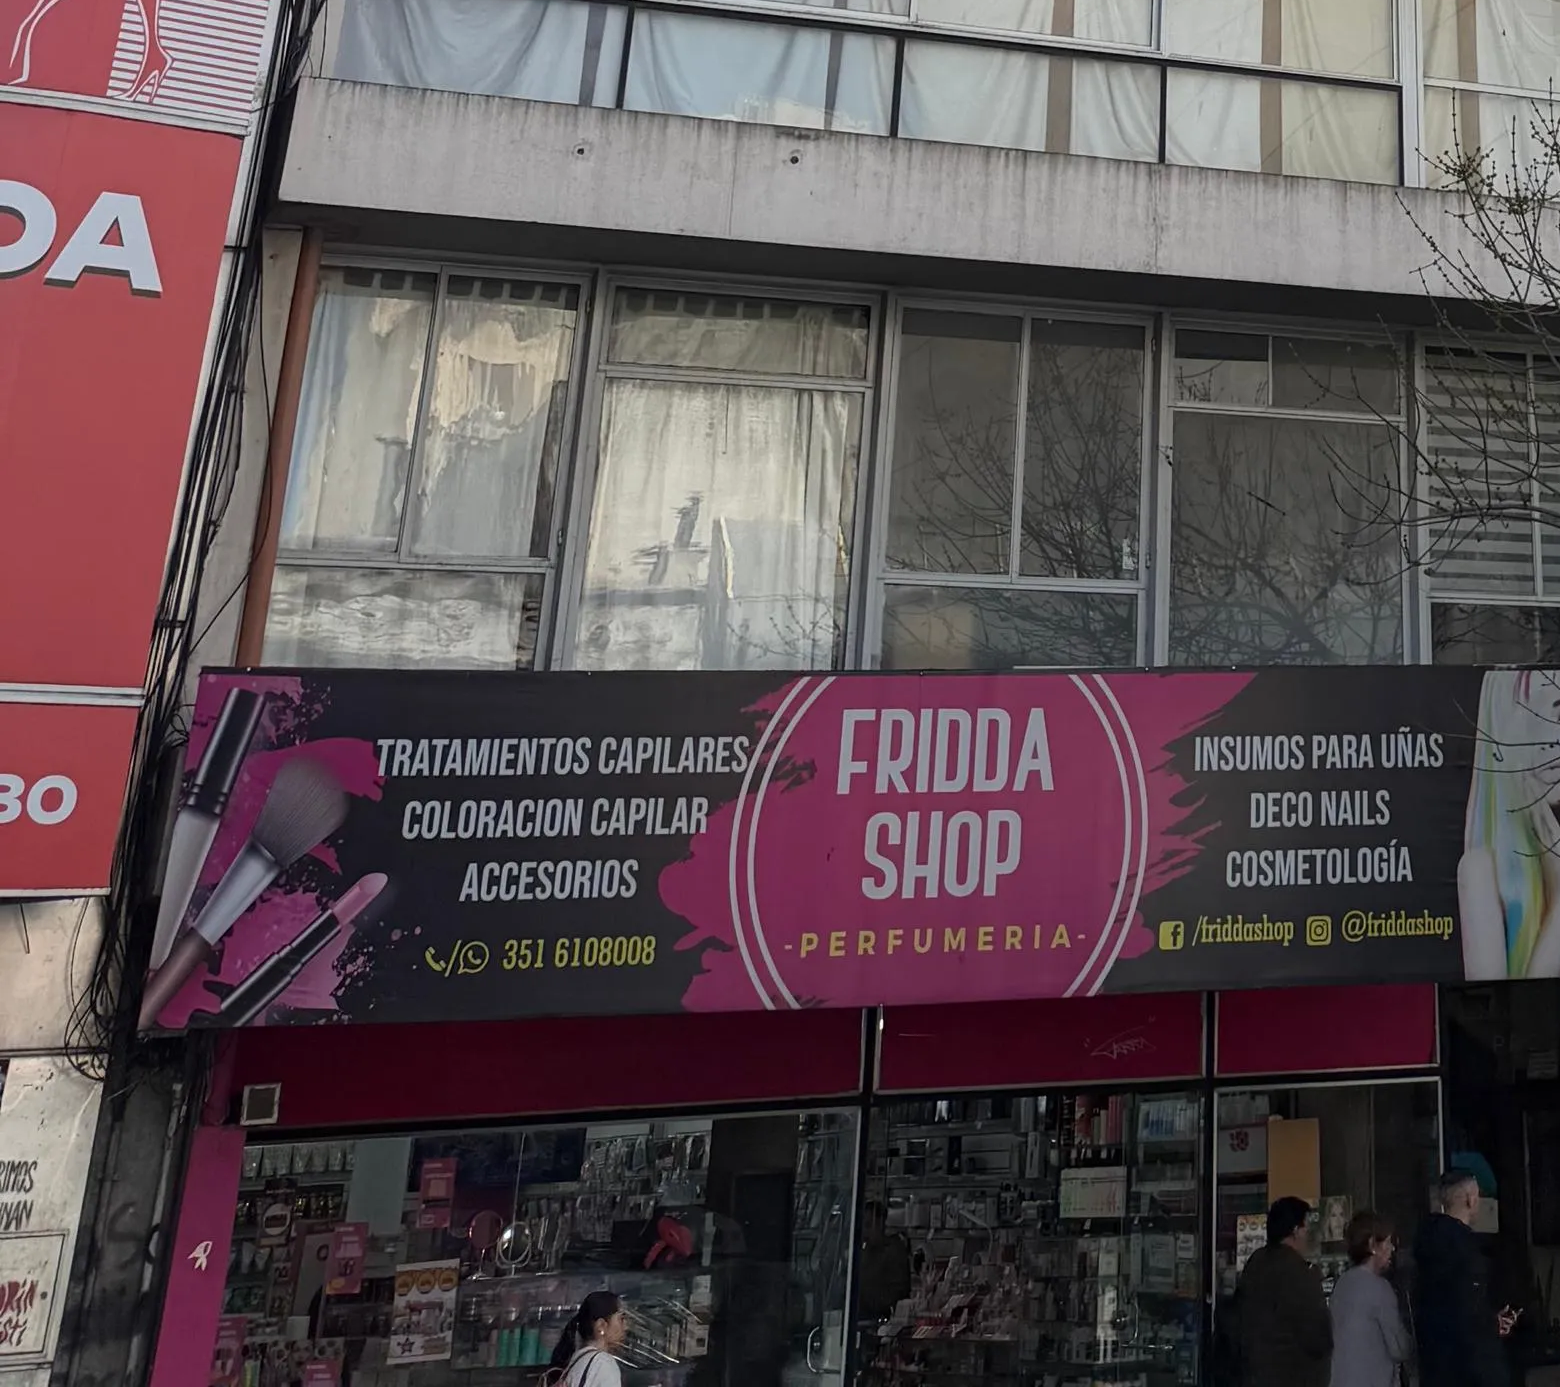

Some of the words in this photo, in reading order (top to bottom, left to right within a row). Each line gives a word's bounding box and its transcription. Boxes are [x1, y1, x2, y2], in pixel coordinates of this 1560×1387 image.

[376, 736, 592, 777] TRATAMIENTOS
[597, 735, 750, 774] CAPILARES
[836, 707, 1055, 795] FRIDDA
[1194, 734, 1305, 772] INSUMOS
[1312, 733, 1375, 770] PARA
[1381, 727, 1444, 769] UÑAS
[402, 798, 584, 840] COLORACION
[590, 796, 709, 836] CAPILAR
[1250, 791, 1313, 829] DECO
[1320, 789, 1391, 827] NAILS
[861, 809, 1022, 900] SHOP
[1226, 839, 1413, 888] COSMETOLOGÍA
[459, 858, 640, 902] ACCESORIOS
[1341, 909, 1454, 943] @friddashop
[502, 938, 544, 970] 351
[554, 935, 657, 969] 6108008
